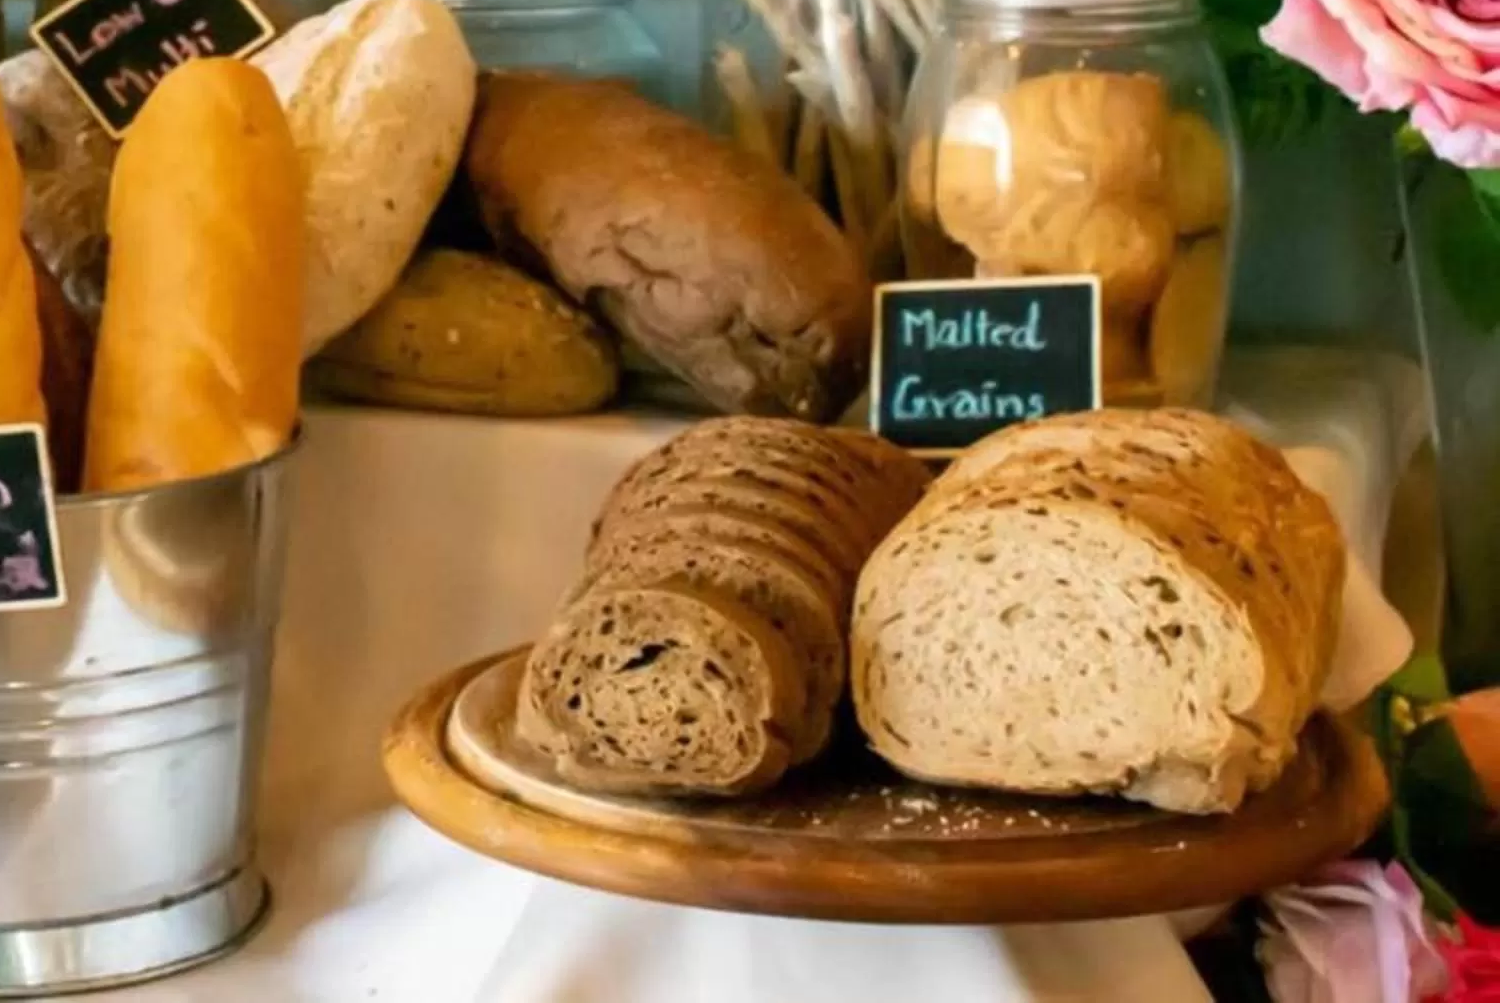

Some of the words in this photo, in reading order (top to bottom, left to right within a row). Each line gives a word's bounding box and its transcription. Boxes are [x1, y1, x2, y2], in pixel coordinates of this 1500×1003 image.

[54, 1, 146, 65] Low
[901, 300, 1046, 350] Malted
[891, 374, 1046, 421] Grains
